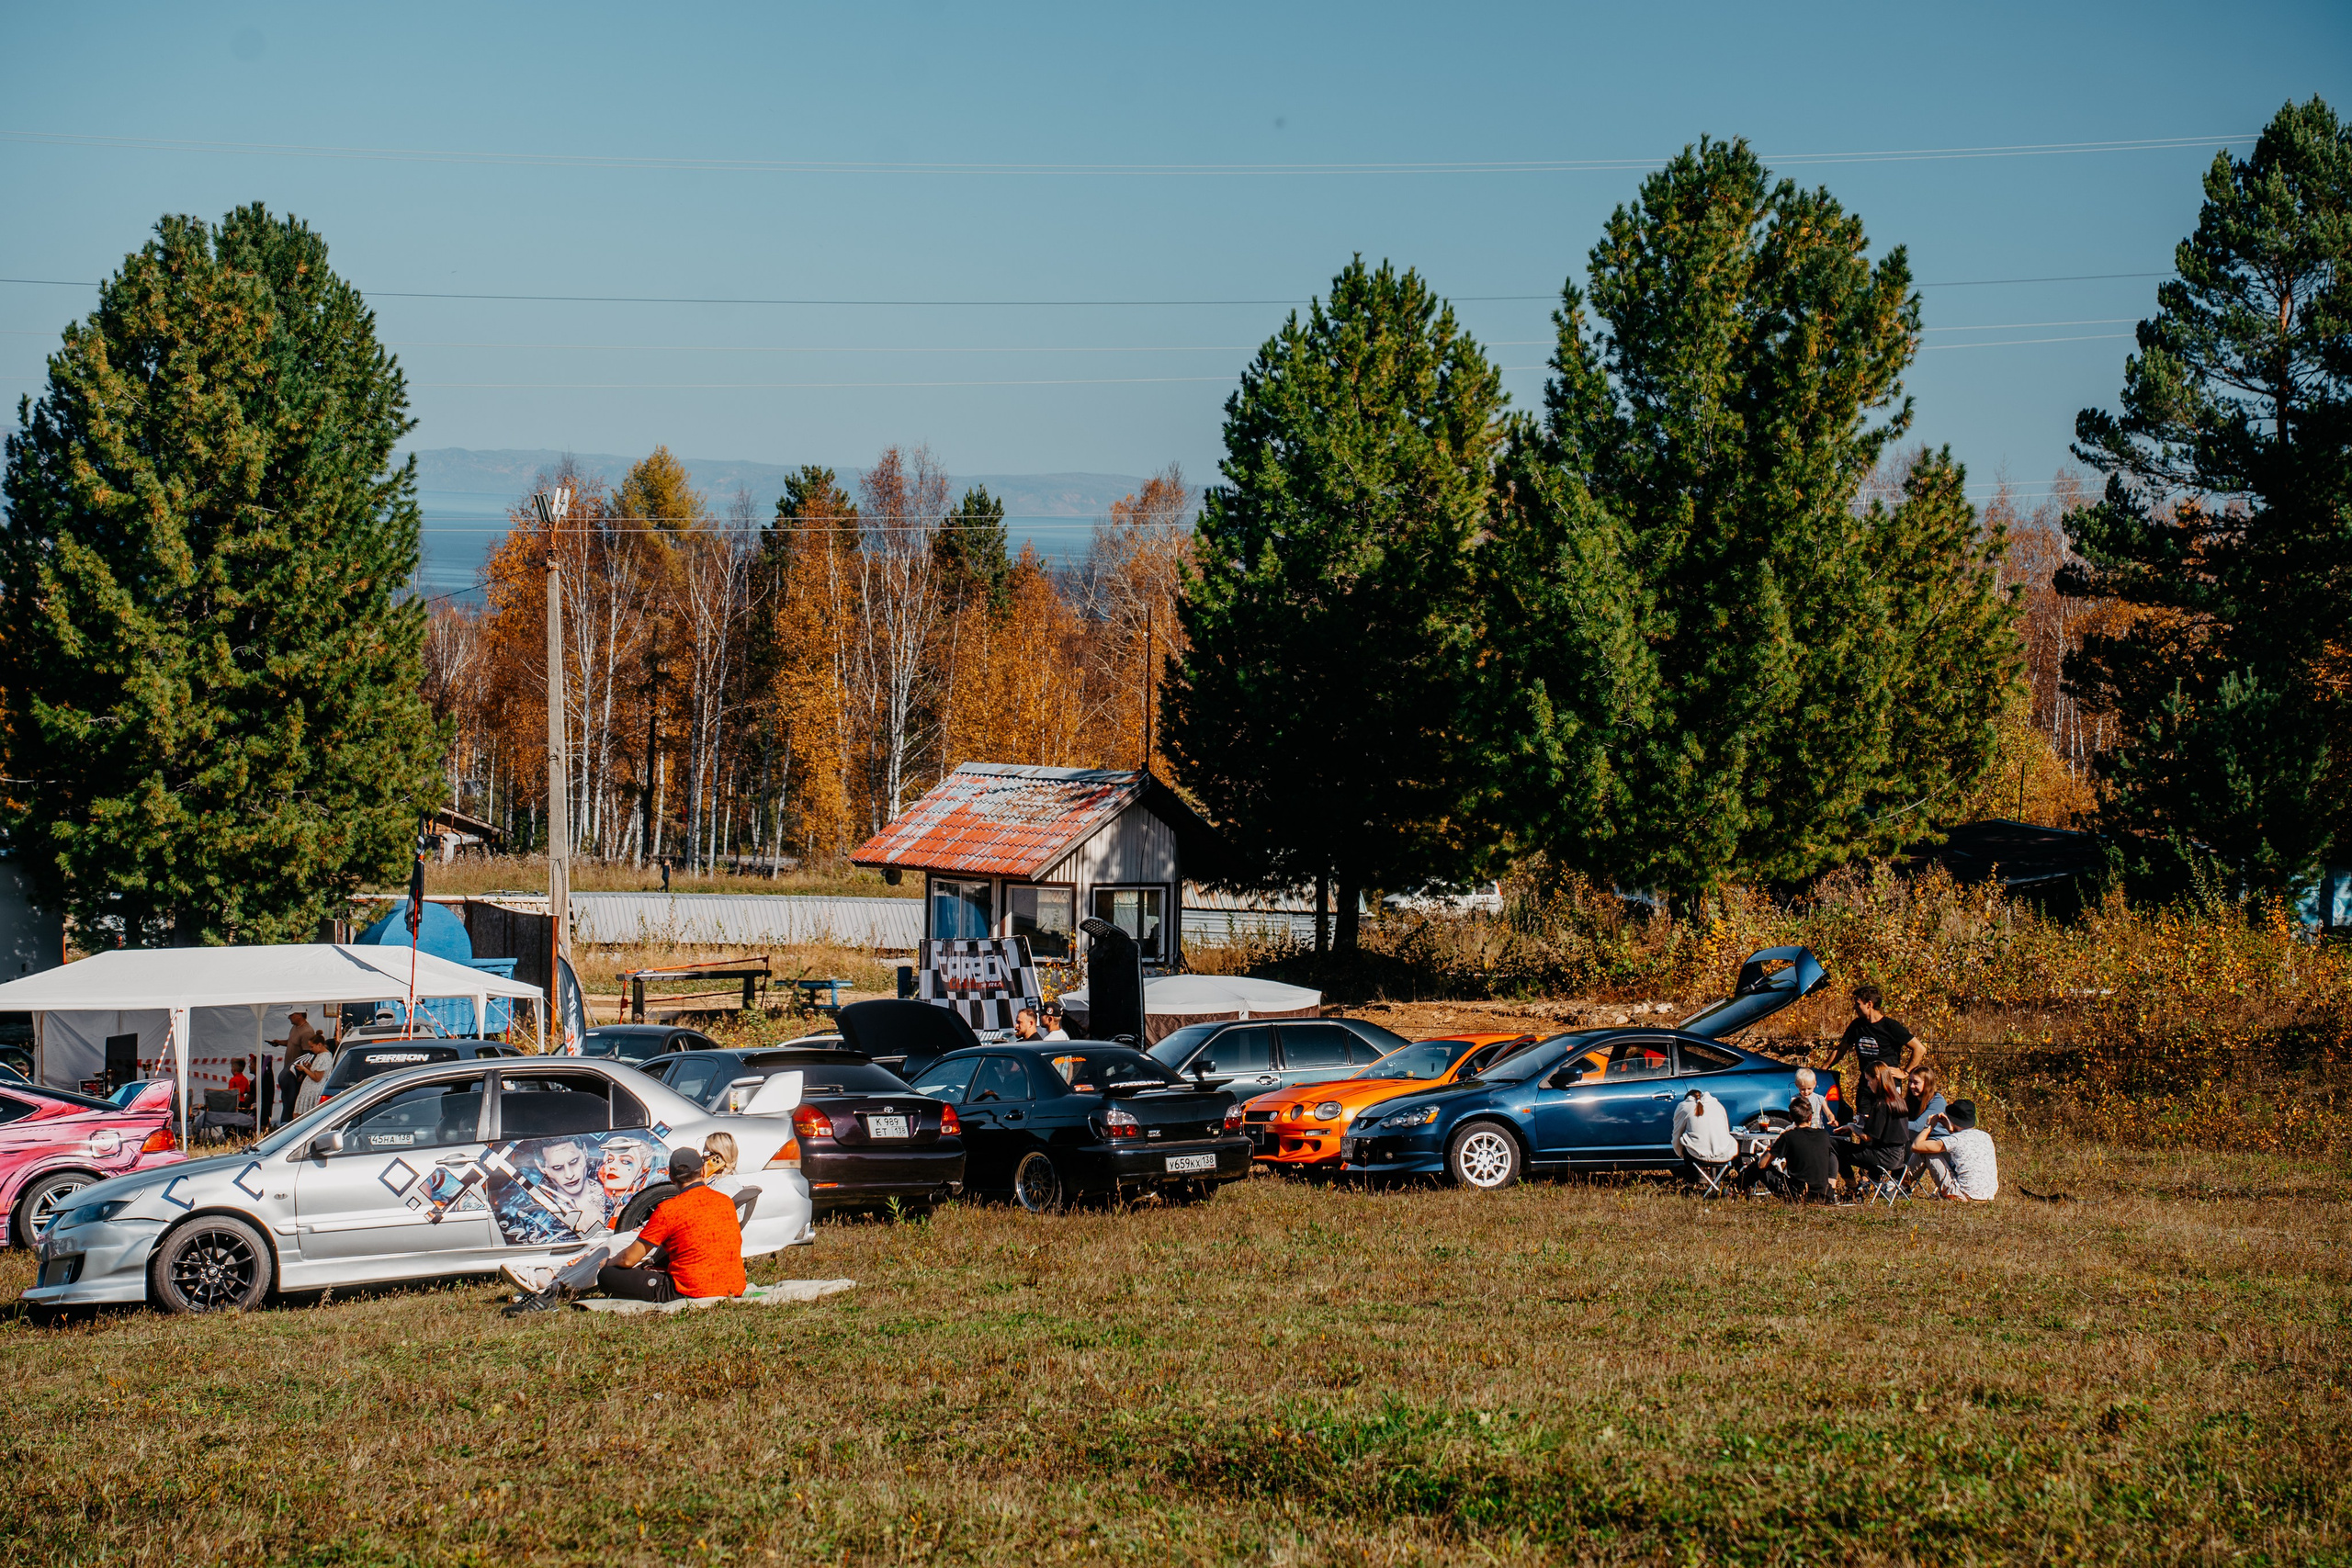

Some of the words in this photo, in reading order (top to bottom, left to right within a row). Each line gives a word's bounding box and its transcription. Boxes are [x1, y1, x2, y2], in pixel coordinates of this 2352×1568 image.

[938, 955, 1012, 983] CARBON
[365, 1054, 429, 1063] CARBON
[884, 1118, 899, 1126] 989
[1202, 1156, 1215, 1164] 138
